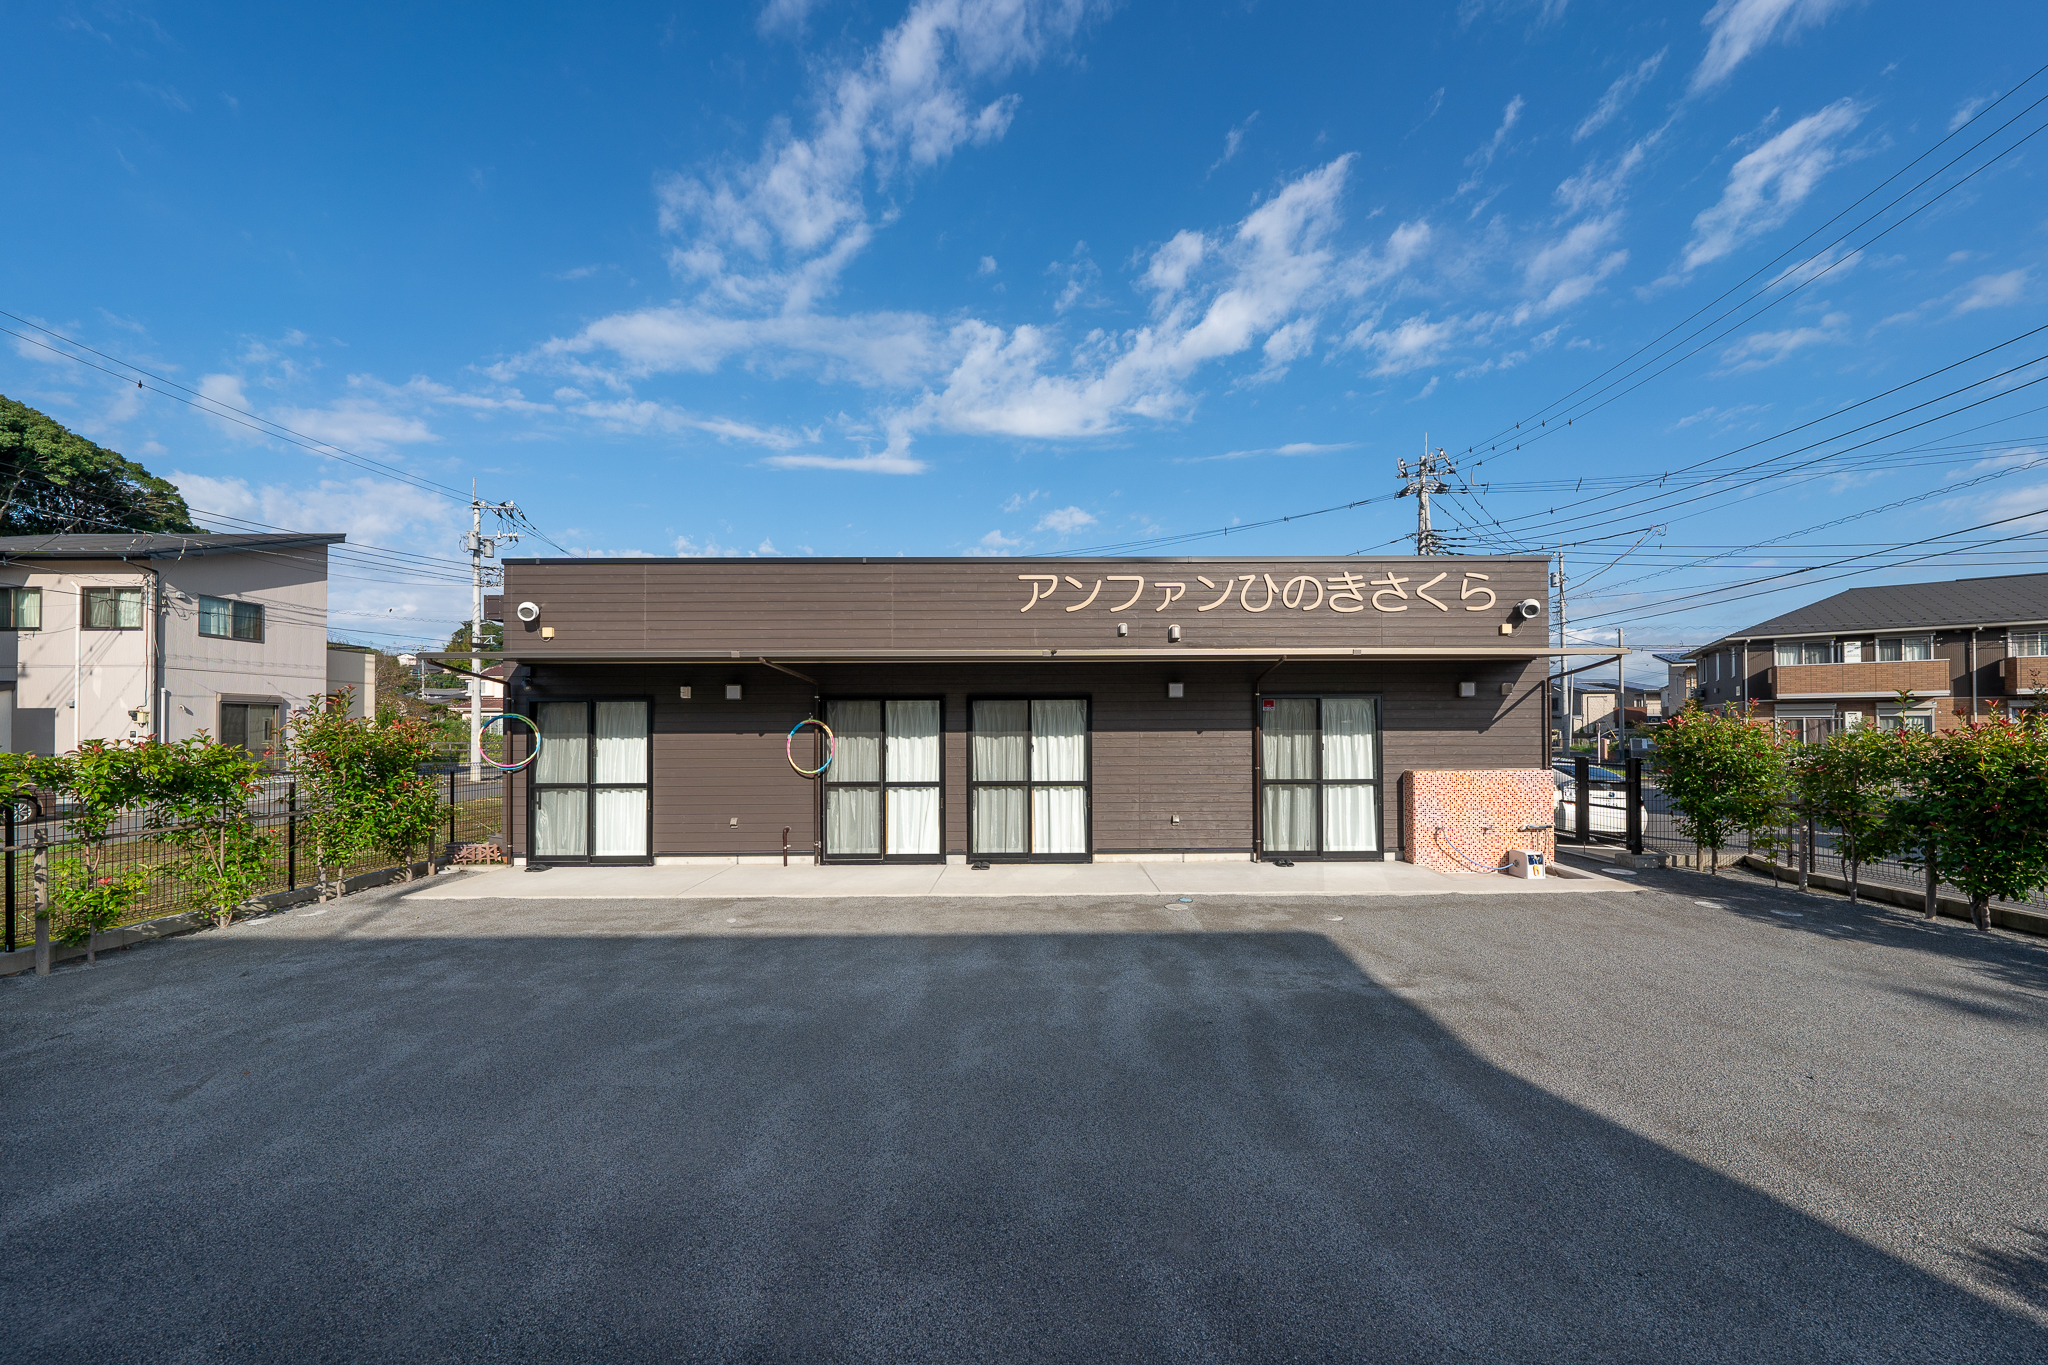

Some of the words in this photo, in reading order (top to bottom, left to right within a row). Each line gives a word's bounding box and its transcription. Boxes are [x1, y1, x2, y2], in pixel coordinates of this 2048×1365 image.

[1018, 571, 1497, 613] アンファンひのきさくら
